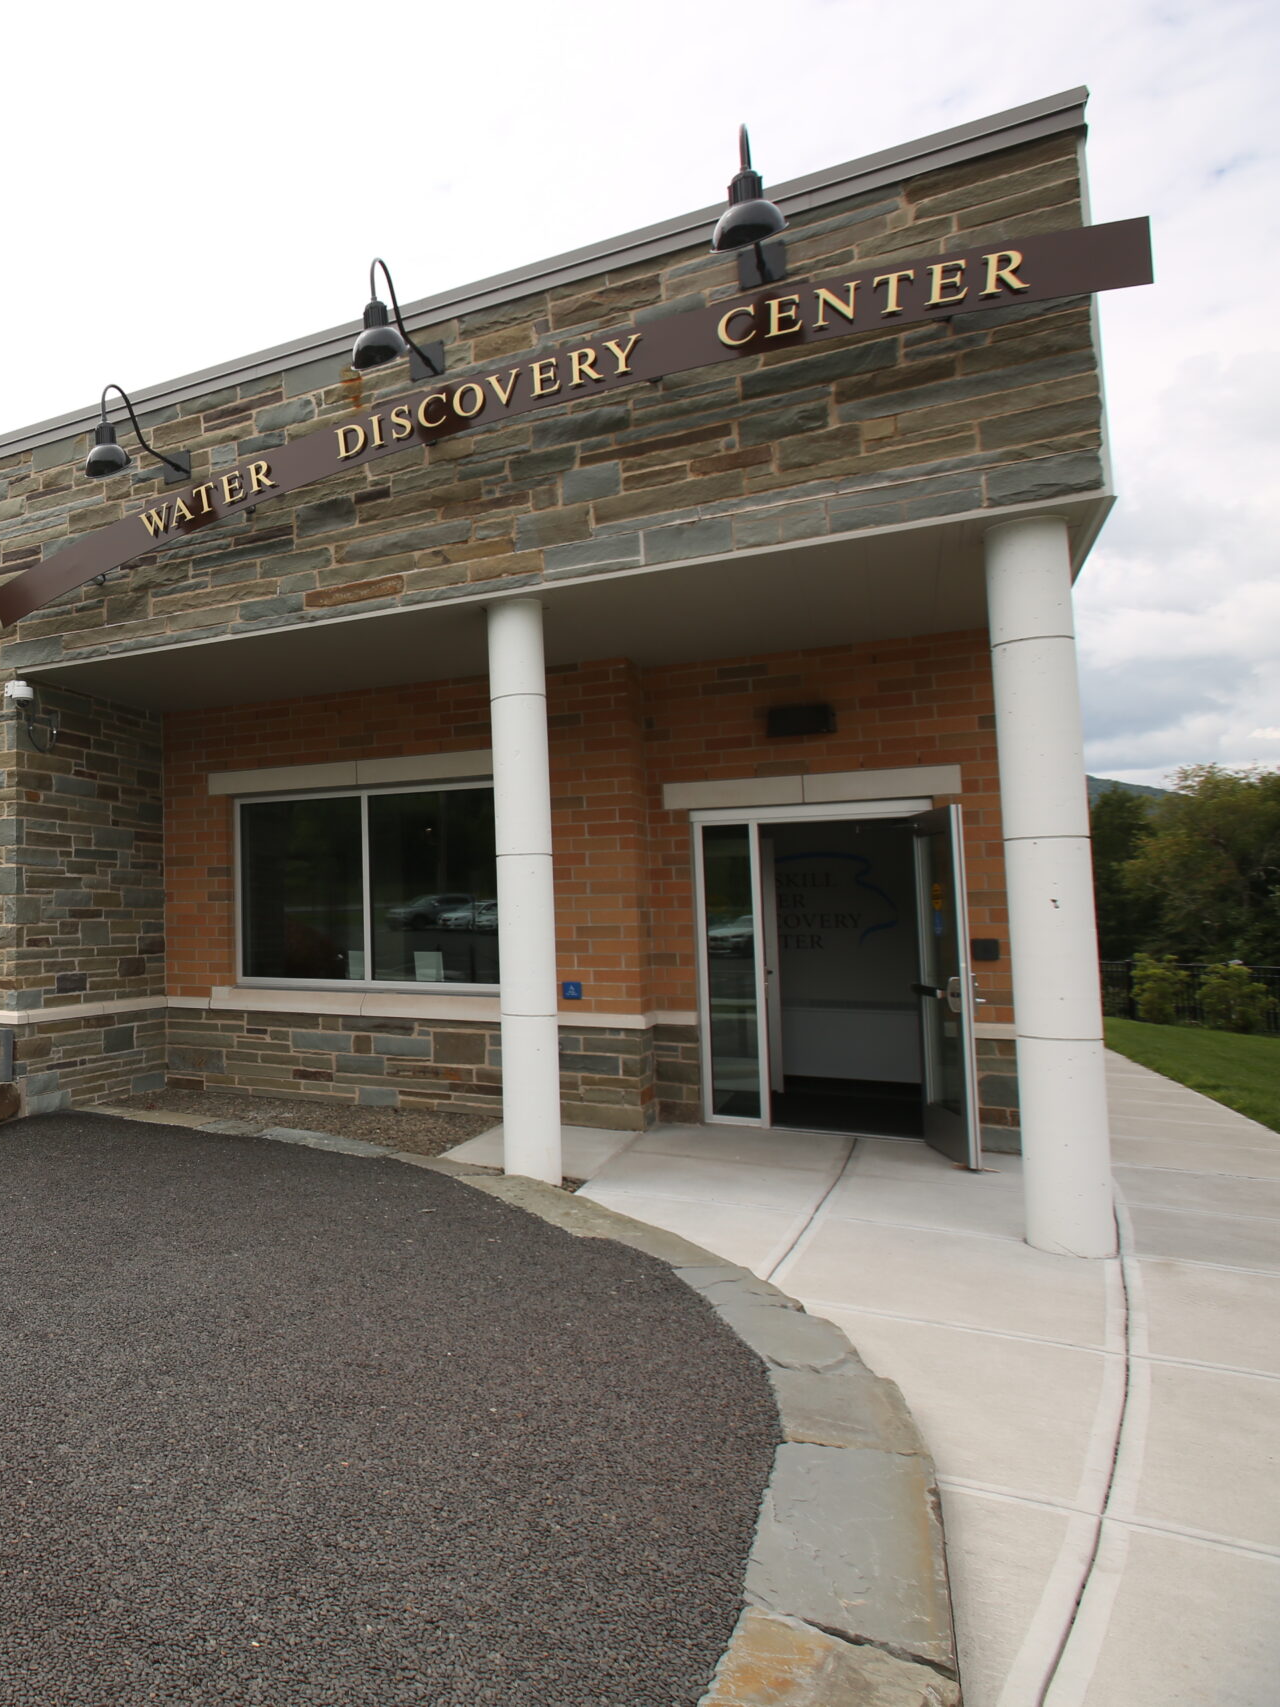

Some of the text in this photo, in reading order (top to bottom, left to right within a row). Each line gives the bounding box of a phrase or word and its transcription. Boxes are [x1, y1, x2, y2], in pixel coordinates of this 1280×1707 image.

[138, 250, 1031, 537] WATER DISCOVERY CENTER
[775, 872, 838, 888] SKILL
[779, 934, 825, 950] TER
